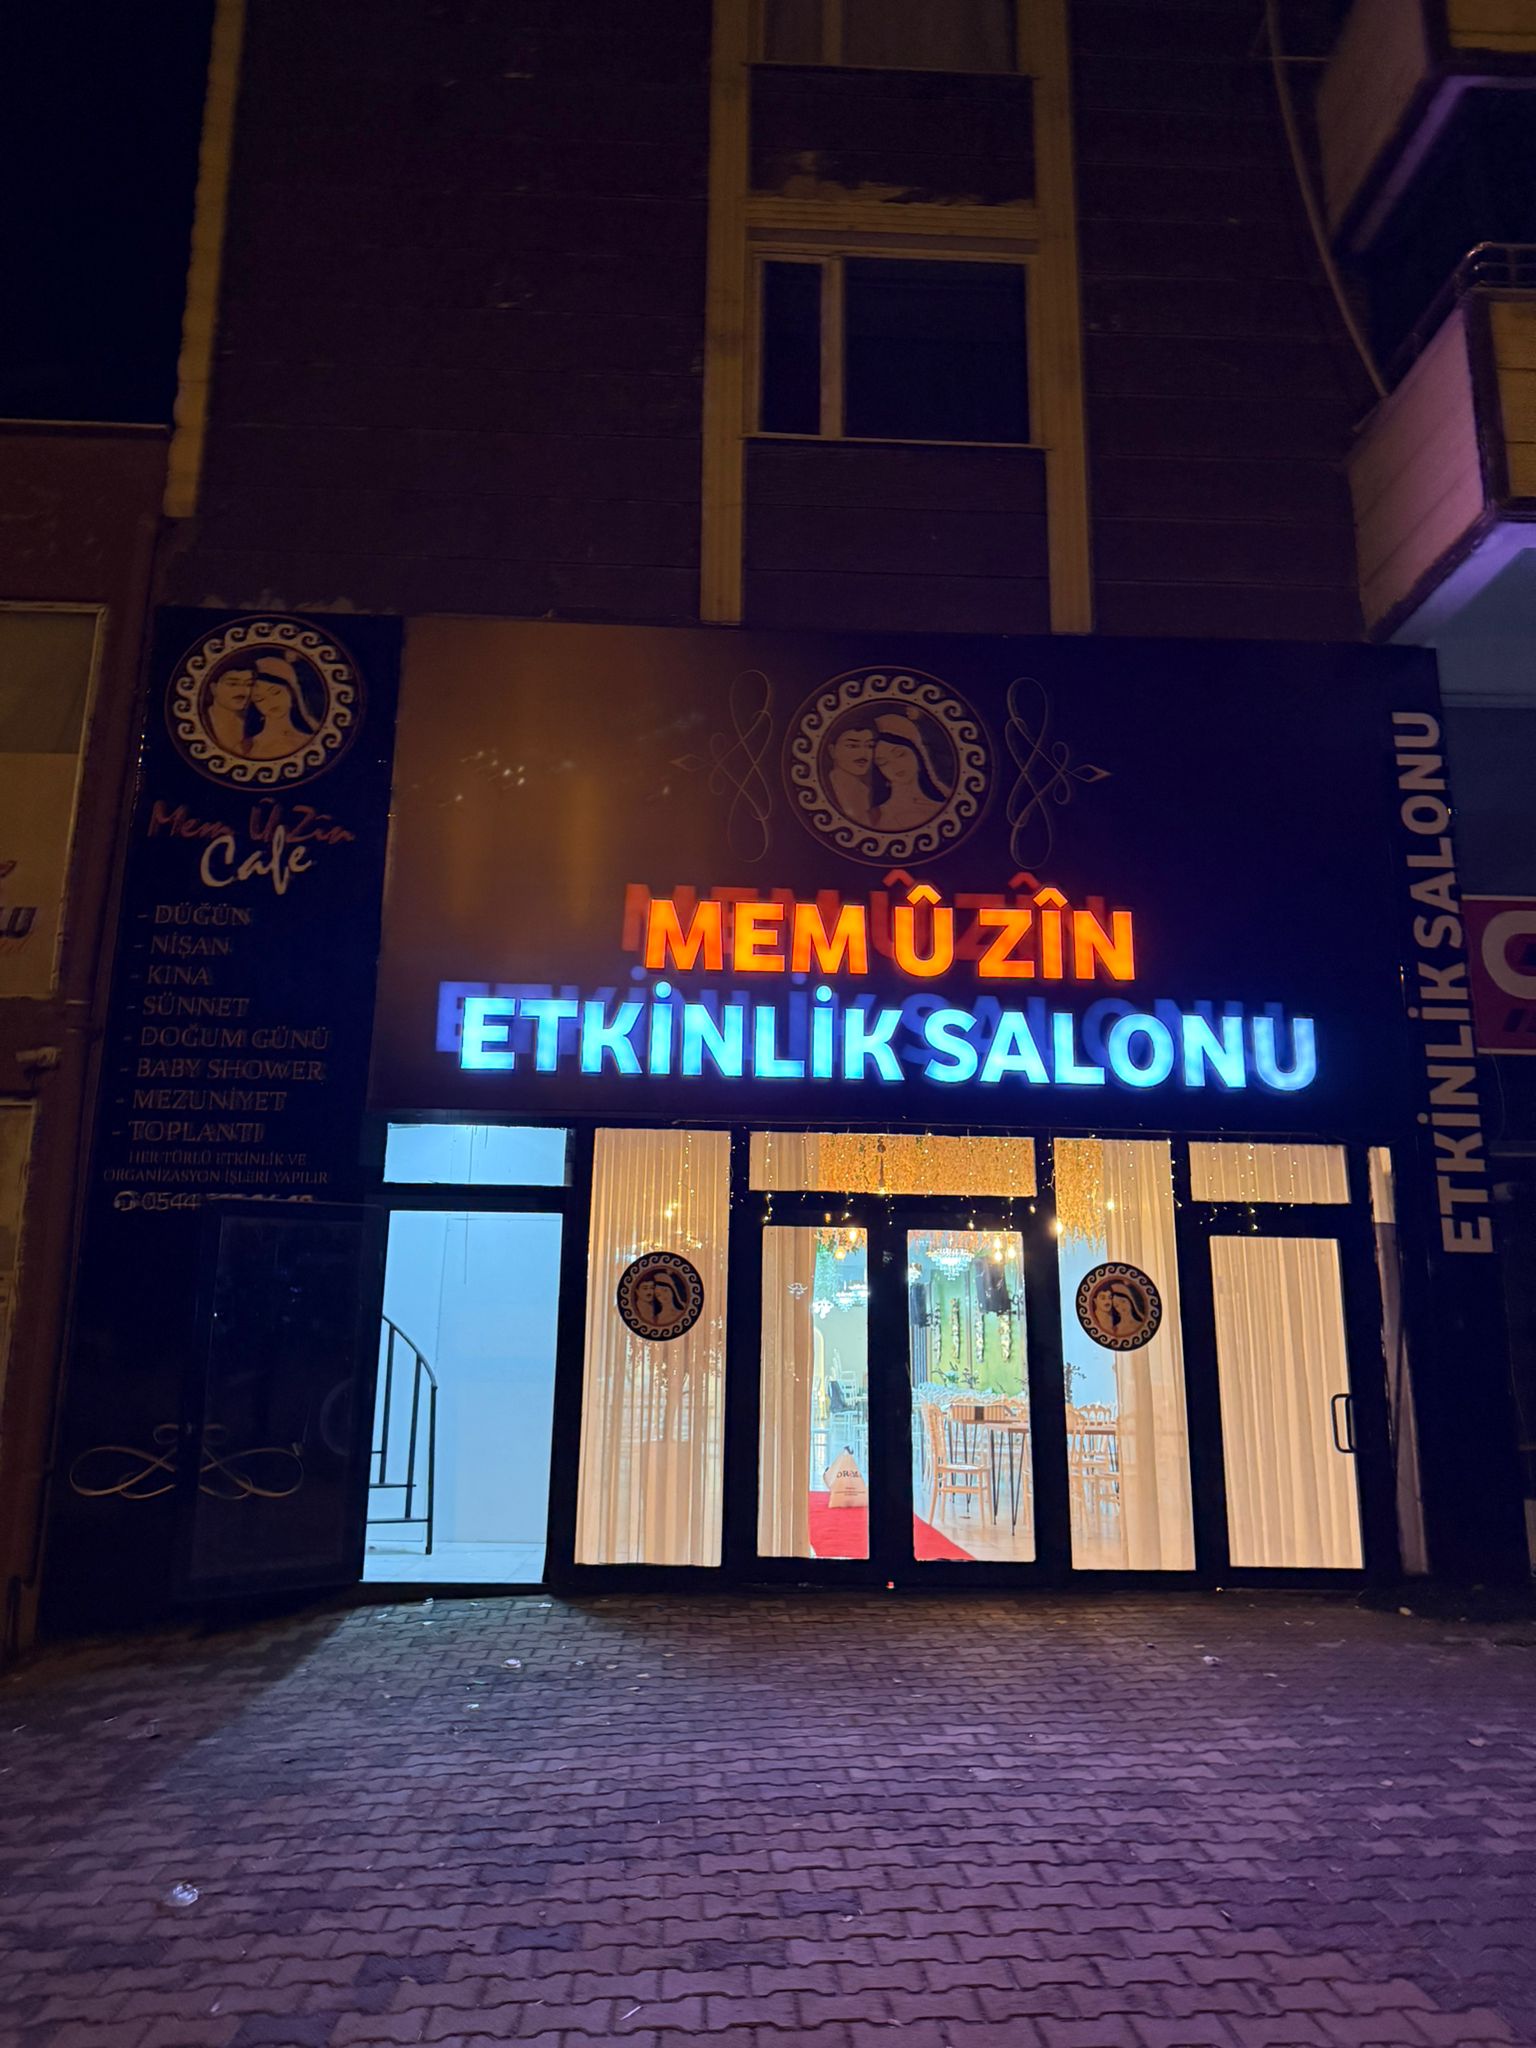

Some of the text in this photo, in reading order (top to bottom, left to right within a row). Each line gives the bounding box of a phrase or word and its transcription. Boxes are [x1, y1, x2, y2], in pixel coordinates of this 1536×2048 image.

[147, 799, 234, 839] Mem
[153, 901, 252, 926] DÜĞÜN
[149, 932, 231, 958] NİŞAN
[643, 884, 1136, 982] MEM Û ZÎN
[146, 964, 210, 986] KINA
[1390, 710, 1496, 1255] ETKİNLİK SALONU
[142, 992, 251, 1017] SÜNNET
[140, 1024, 330, 1050] DOĞUM GÜNÜ
[458, 980, 1317, 1091] ETKİNLİK SALONU
[136, 1056, 325, 1081] BABY SHOWER
[132, 1087, 288, 1112] MEZUNİYET
[127, 1120, 266, 1143] TOPLANTI
